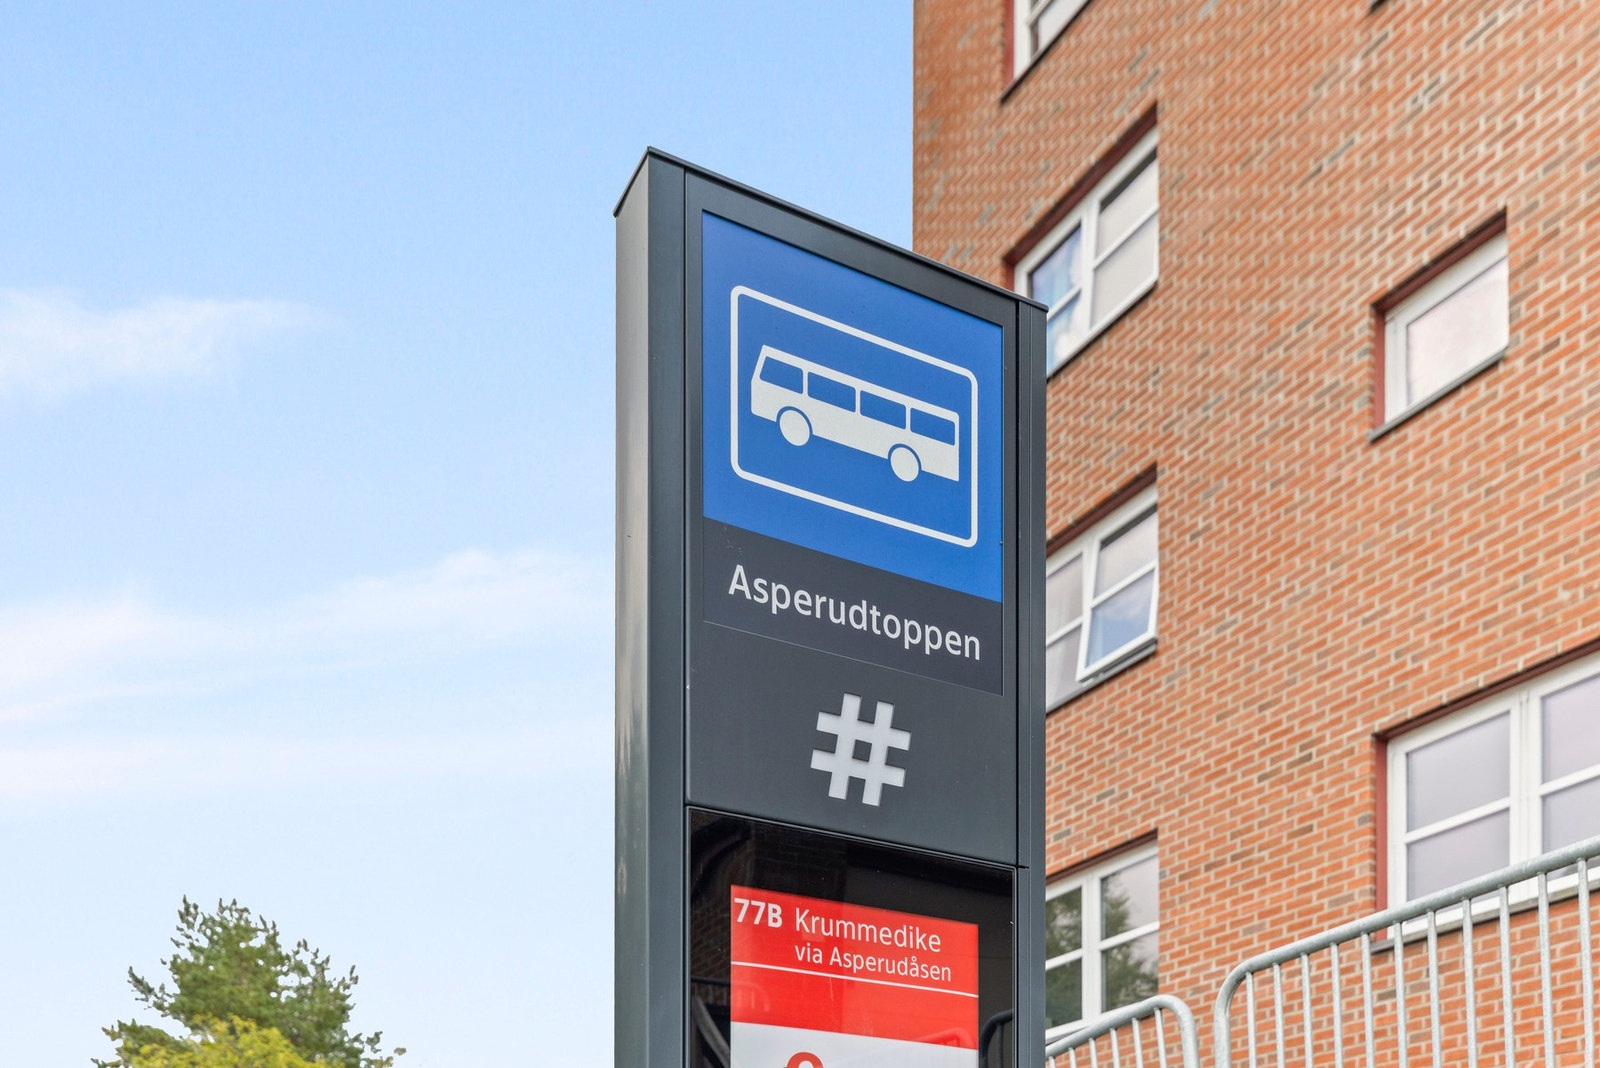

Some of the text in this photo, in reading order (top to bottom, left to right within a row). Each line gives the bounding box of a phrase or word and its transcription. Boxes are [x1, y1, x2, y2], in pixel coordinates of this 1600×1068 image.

[728, 564, 981, 660] Asperudtoppen
[734, 897, 942, 953] 77B Krummedike
[795, 943, 952, 982] via Asperudåsen
